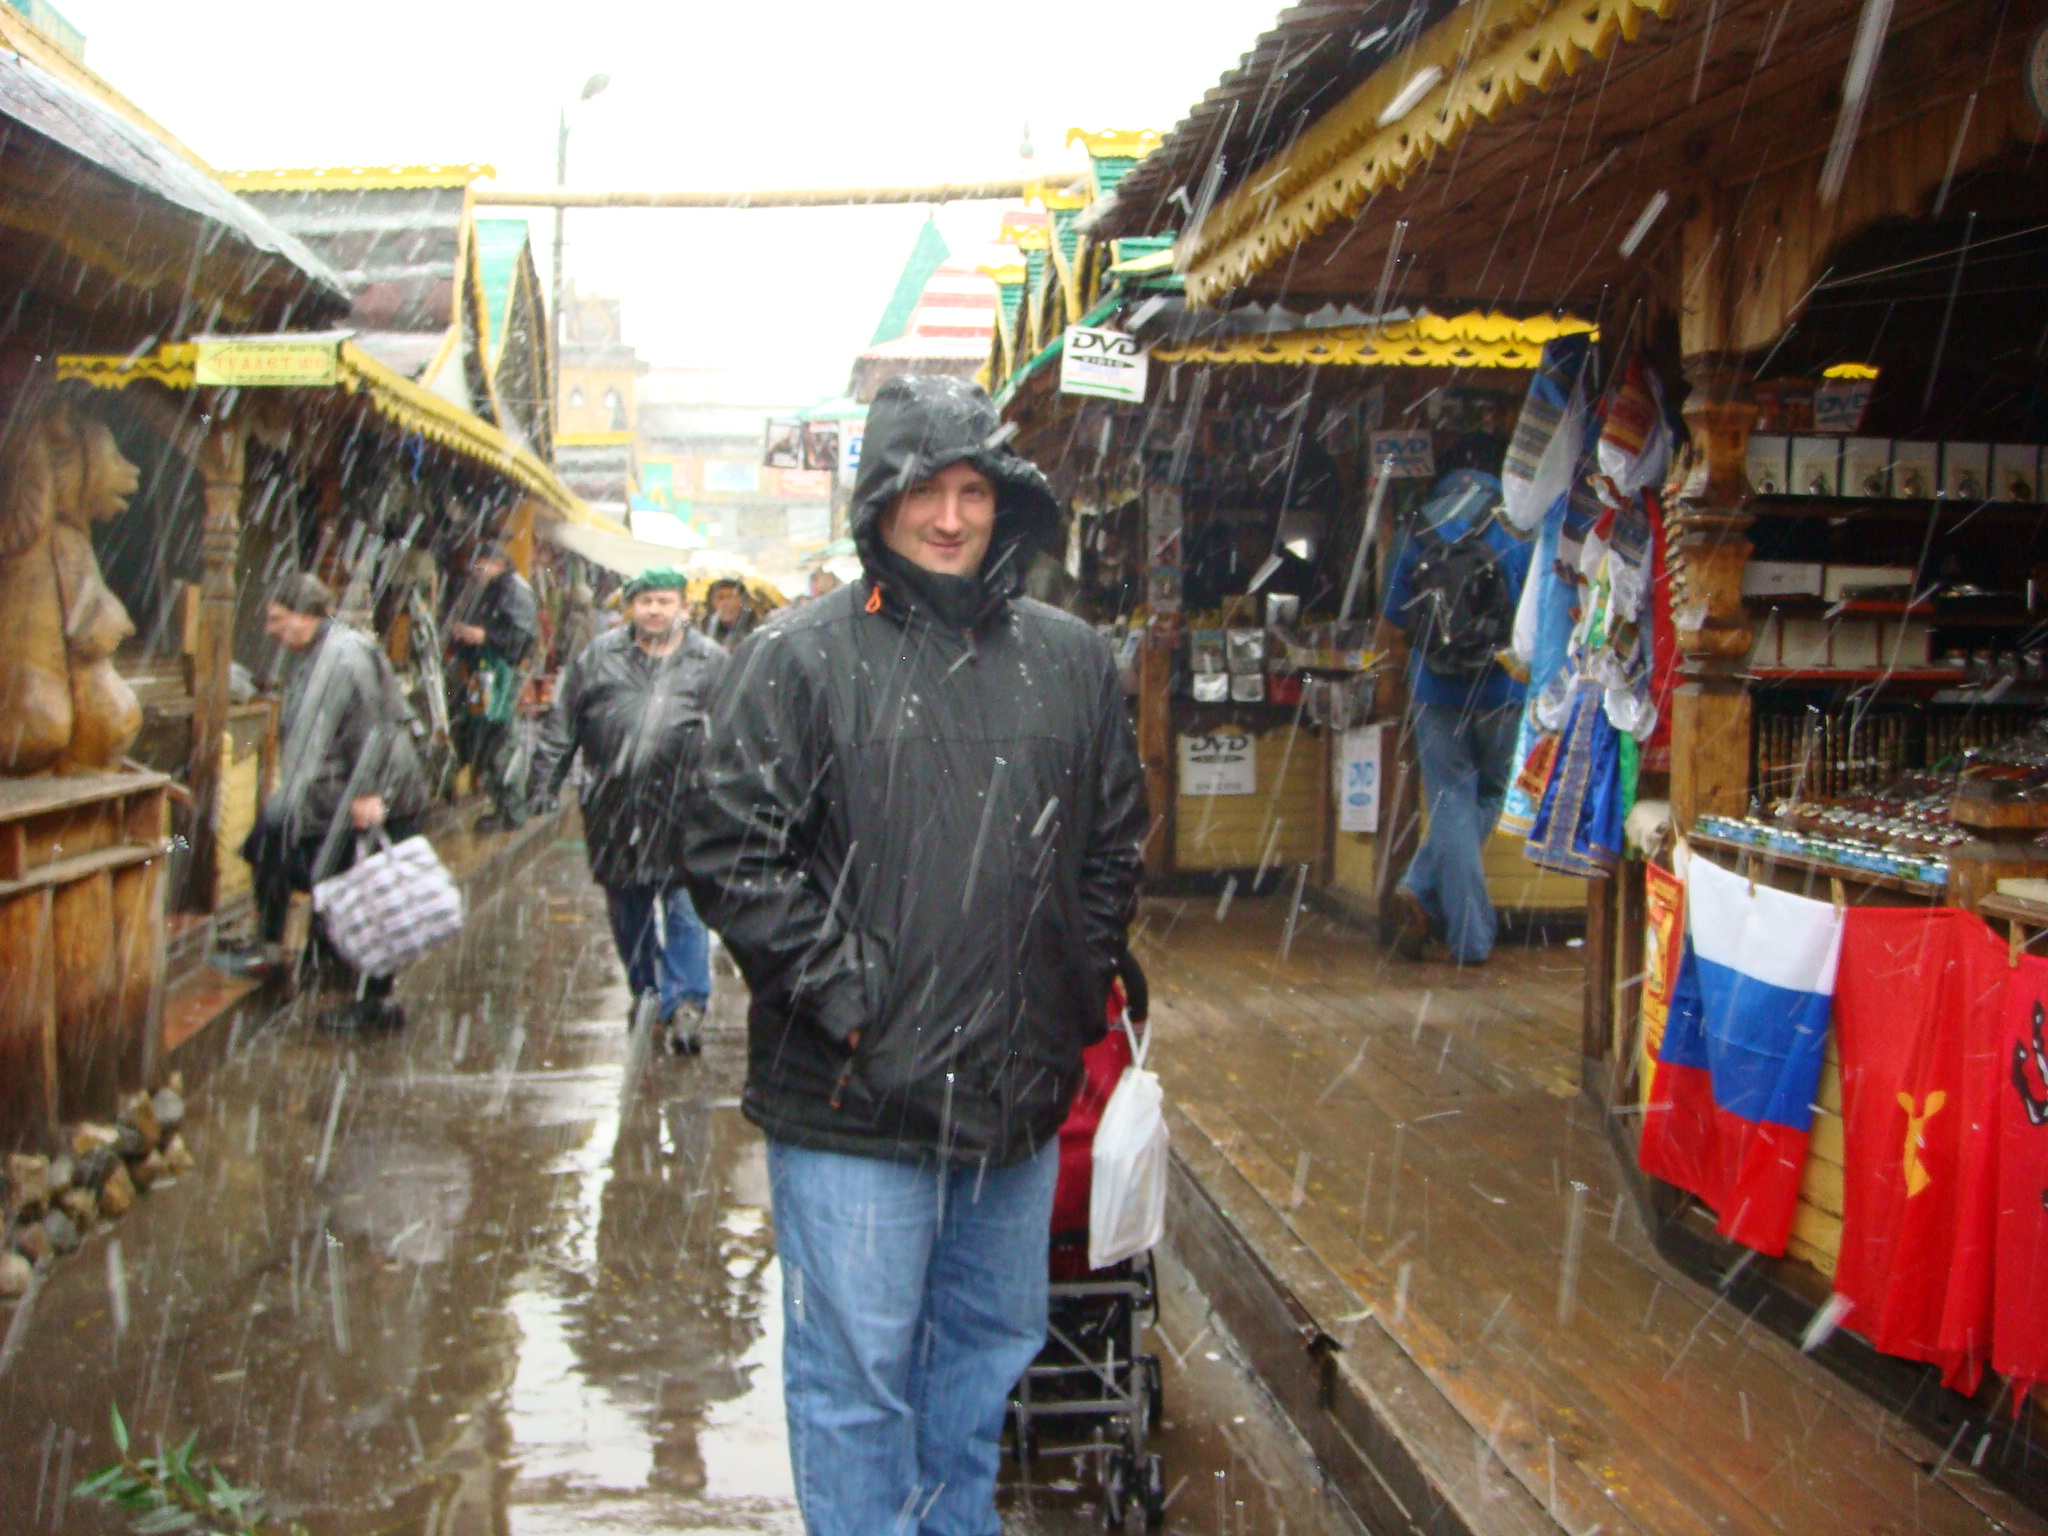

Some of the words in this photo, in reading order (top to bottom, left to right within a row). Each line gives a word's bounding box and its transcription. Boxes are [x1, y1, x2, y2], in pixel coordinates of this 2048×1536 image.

[1072, 331, 1140, 356] DVD
[1375, 438, 1428, 455] DVD
[1190, 735, 1248, 752] DVD
